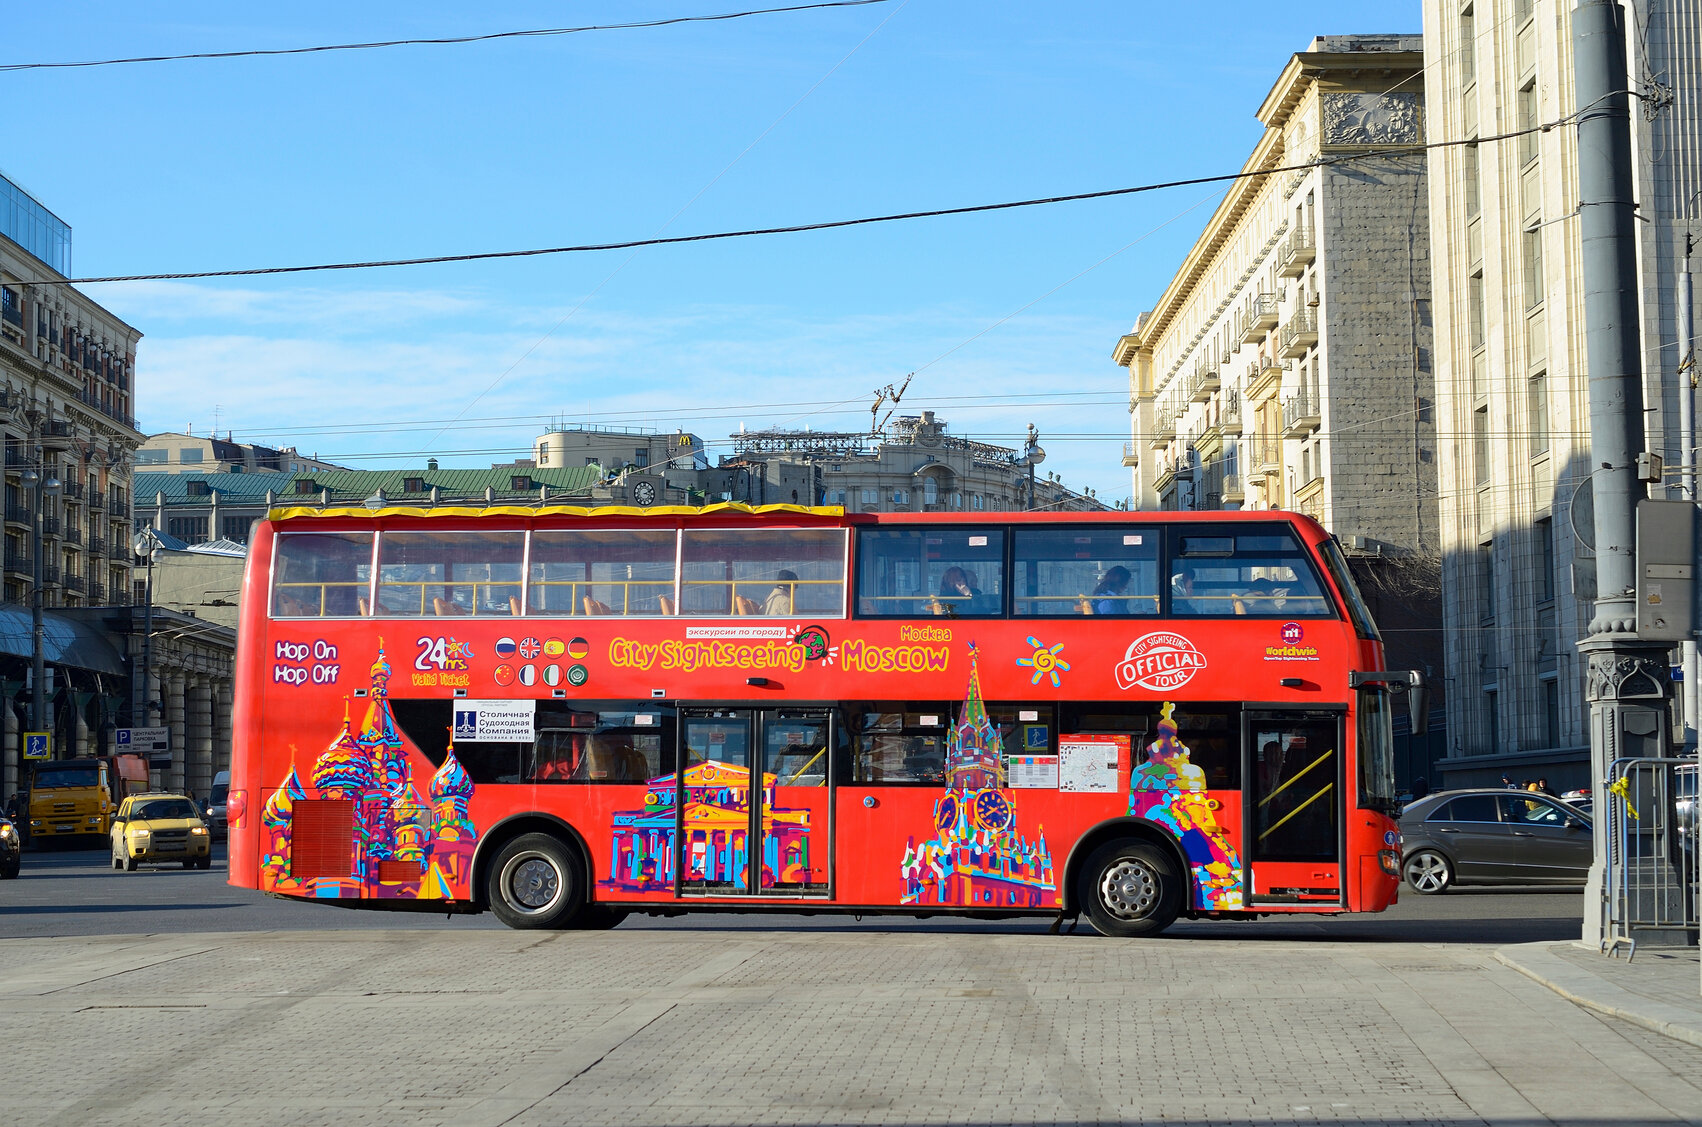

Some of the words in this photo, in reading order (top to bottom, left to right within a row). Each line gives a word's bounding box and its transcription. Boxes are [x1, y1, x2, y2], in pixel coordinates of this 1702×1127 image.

[678, 435, 691, 447] M
[688, 629, 736, 637] экскурсии
[752, 629, 785, 637] городу
[901, 625, 952, 641] Москва
[275, 640, 310, 662] Hop
[313, 639, 338, 660] On
[415, 636, 447, 670] 24
[1134, 642, 1148, 655] CITY
[1147, 635, 1188, 650] SIGHTSEEING
[1265, 646, 1318, 656] Worldwide
[609, 637, 658, 671] City
[660, 640, 806, 672] Sightseeing
[273, 664, 309, 686] Hop
[312, 663, 341, 684] Off
[1122, 653, 1204, 682] OFFICIAL
[412, 673, 437, 686] Valid
[439, 673, 470, 687] Ticket
[1155, 670, 1188, 687] TOUR
[479, 710, 530, 718] Столичная
[479, 719, 530, 727] Судоходная
[119, 731, 128, 743] P
